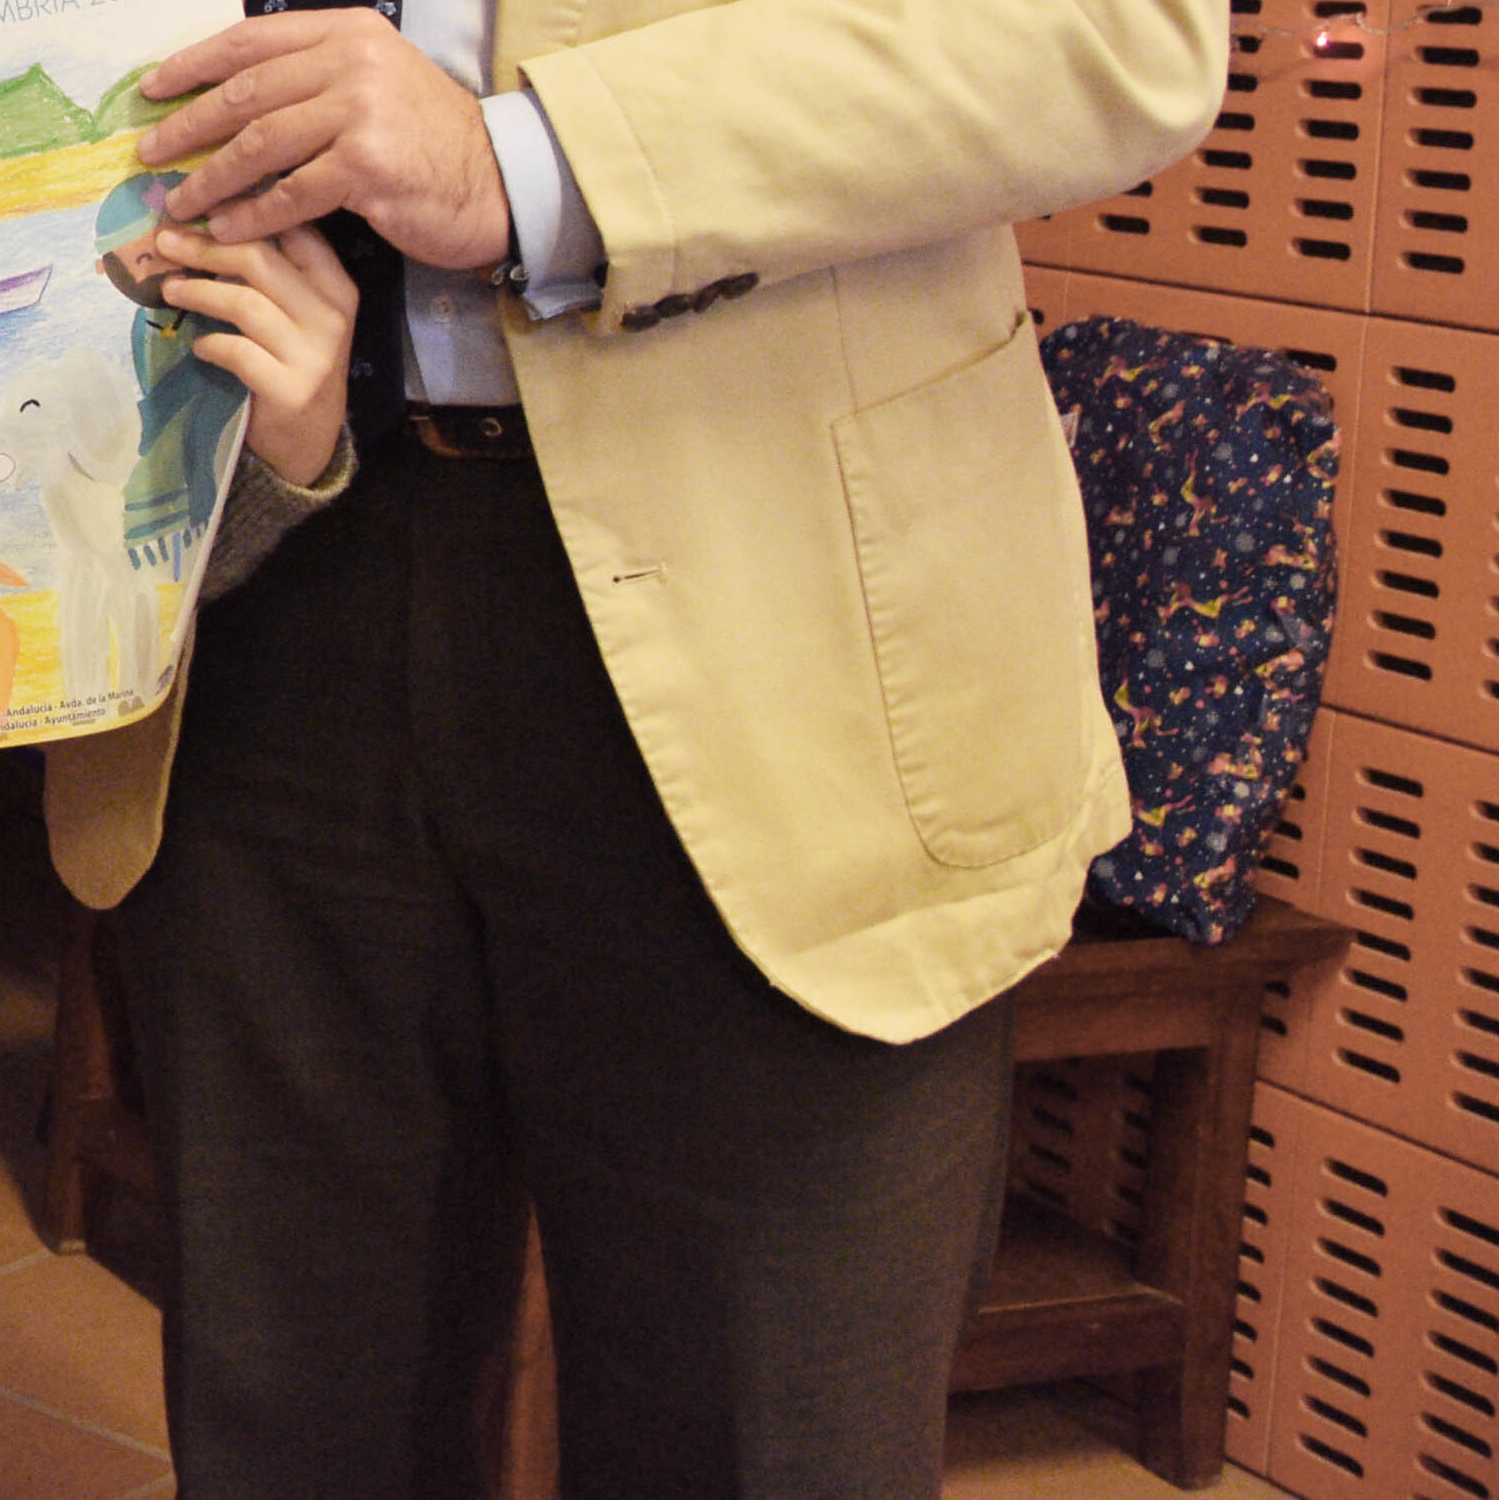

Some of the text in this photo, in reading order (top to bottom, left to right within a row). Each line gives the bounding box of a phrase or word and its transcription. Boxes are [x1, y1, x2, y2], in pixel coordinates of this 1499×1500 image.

[86, 694, 98, 706] de
[98, 691, 107, 703] la
[107, 687, 135, 701] Marina
[44, 706, 108, 726] Ayuntamiento
